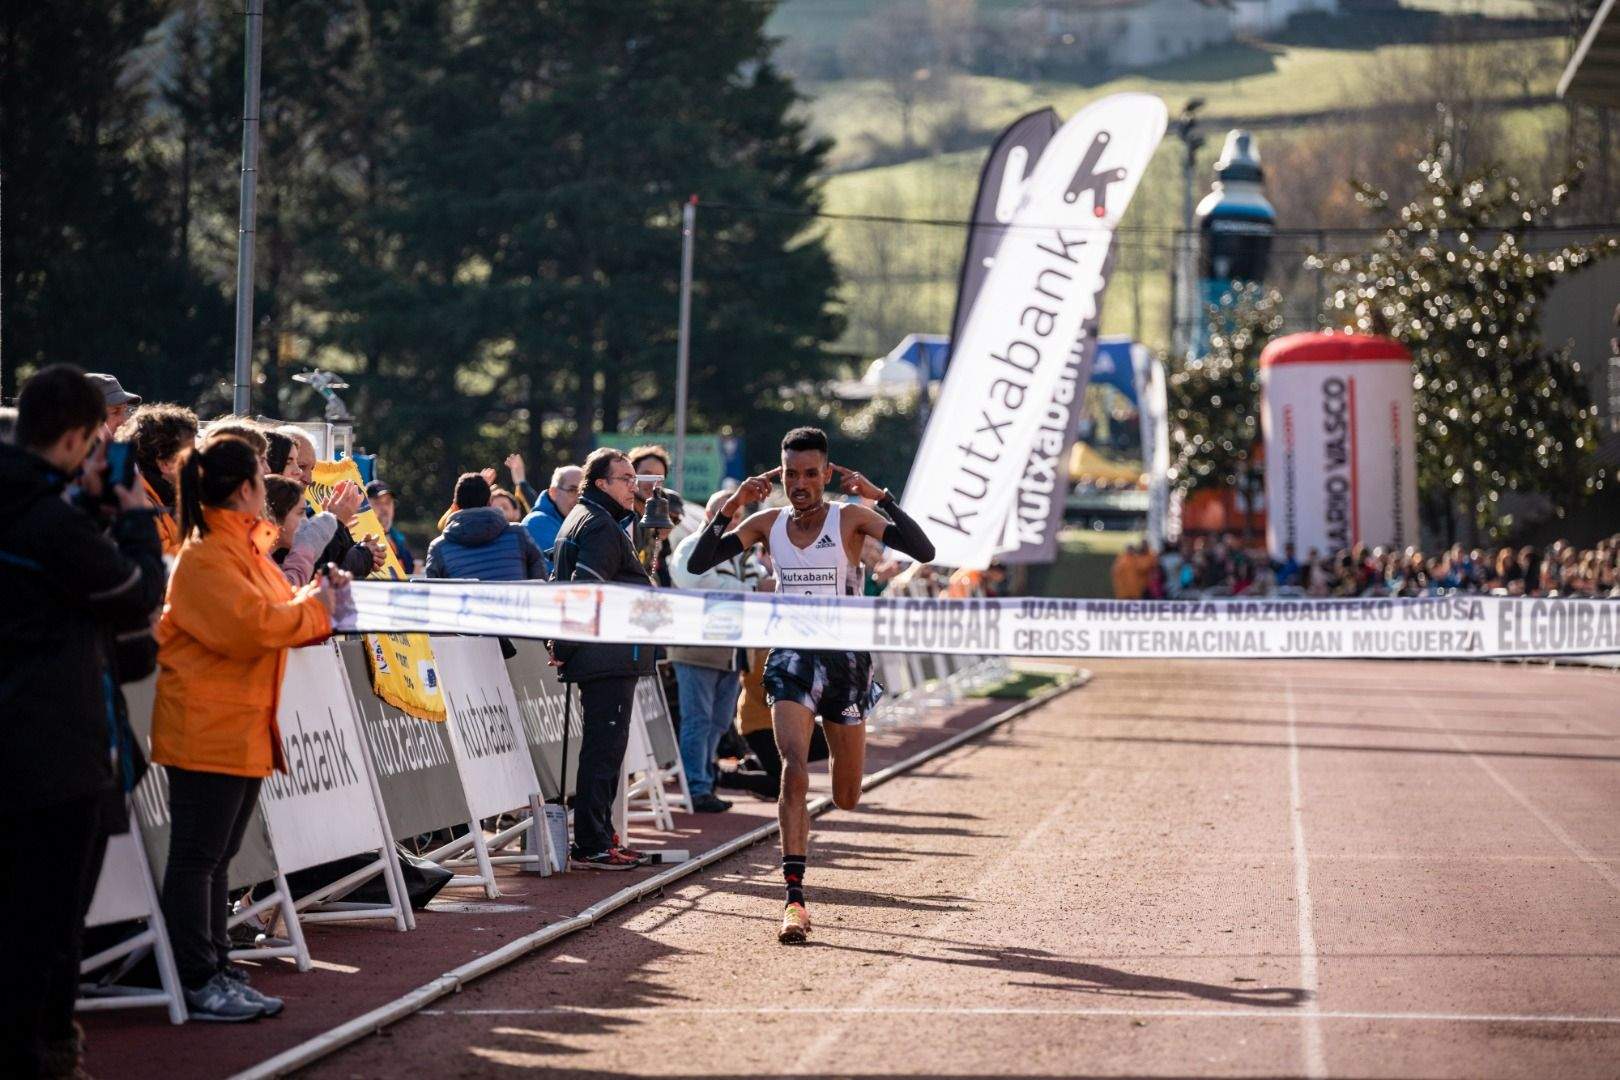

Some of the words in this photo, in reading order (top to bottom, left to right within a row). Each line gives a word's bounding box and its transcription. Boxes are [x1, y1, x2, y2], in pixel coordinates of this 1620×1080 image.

[927, 229, 1088, 536] kutxabank
[1323, 377, 1347, 472] VASCO
[782, 572, 834, 582] kutxabank
[872, 600, 1000, 649] ELGOIBAR
[1013, 601, 1077, 621] JUAN
[1086, 602, 1218, 622] MUGUERZA
[1227, 601, 1393, 622] NAZIOARTEKO
[1403, 600, 1485, 621] KROSA
[1013, 629, 1091, 652] CROSS
[1100, 630, 1271, 652] INTERNACINAL
[1280, 630, 1345, 652] JUAN
[1353, 630, 1485, 652] MUGUERZA
[448, 687, 517, 760] kutxabank
